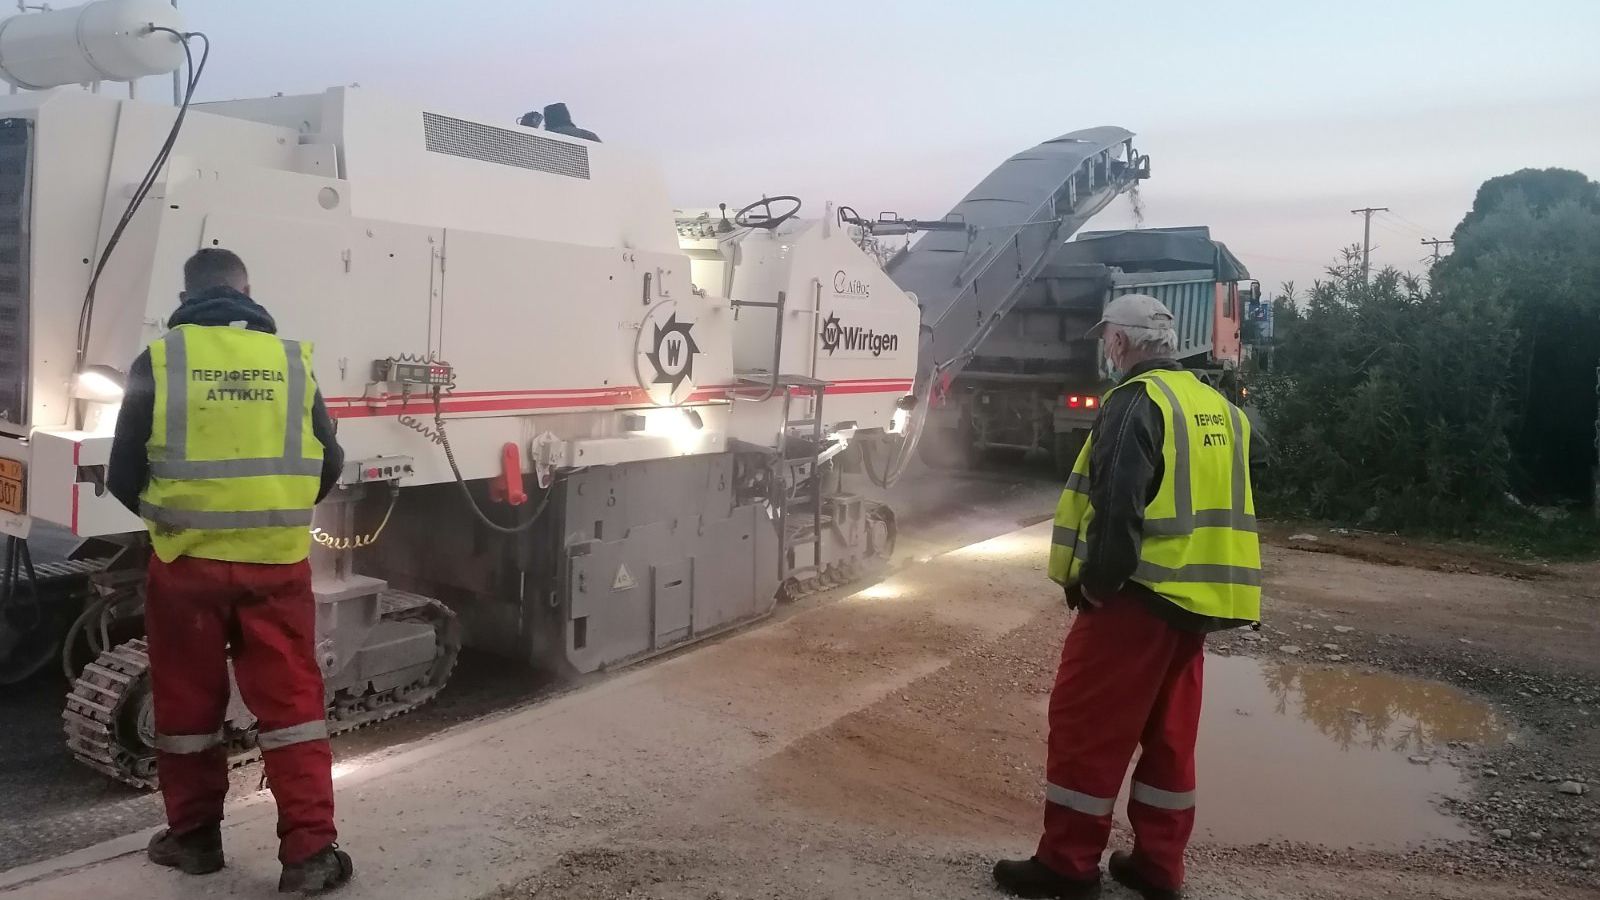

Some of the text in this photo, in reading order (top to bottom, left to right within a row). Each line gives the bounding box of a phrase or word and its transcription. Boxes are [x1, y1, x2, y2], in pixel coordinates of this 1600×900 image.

[844, 326, 898, 357] Wirtgen
[667, 339, 682, 366] W
[192, 368, 285, 382] ΠΕΡΙΦΕΡΕΙΑ
[206, 388, 275, 401] ΑΤΤΙΚΗΣ
[1203, 433, 1227, 447] ΑΤΤΙ
